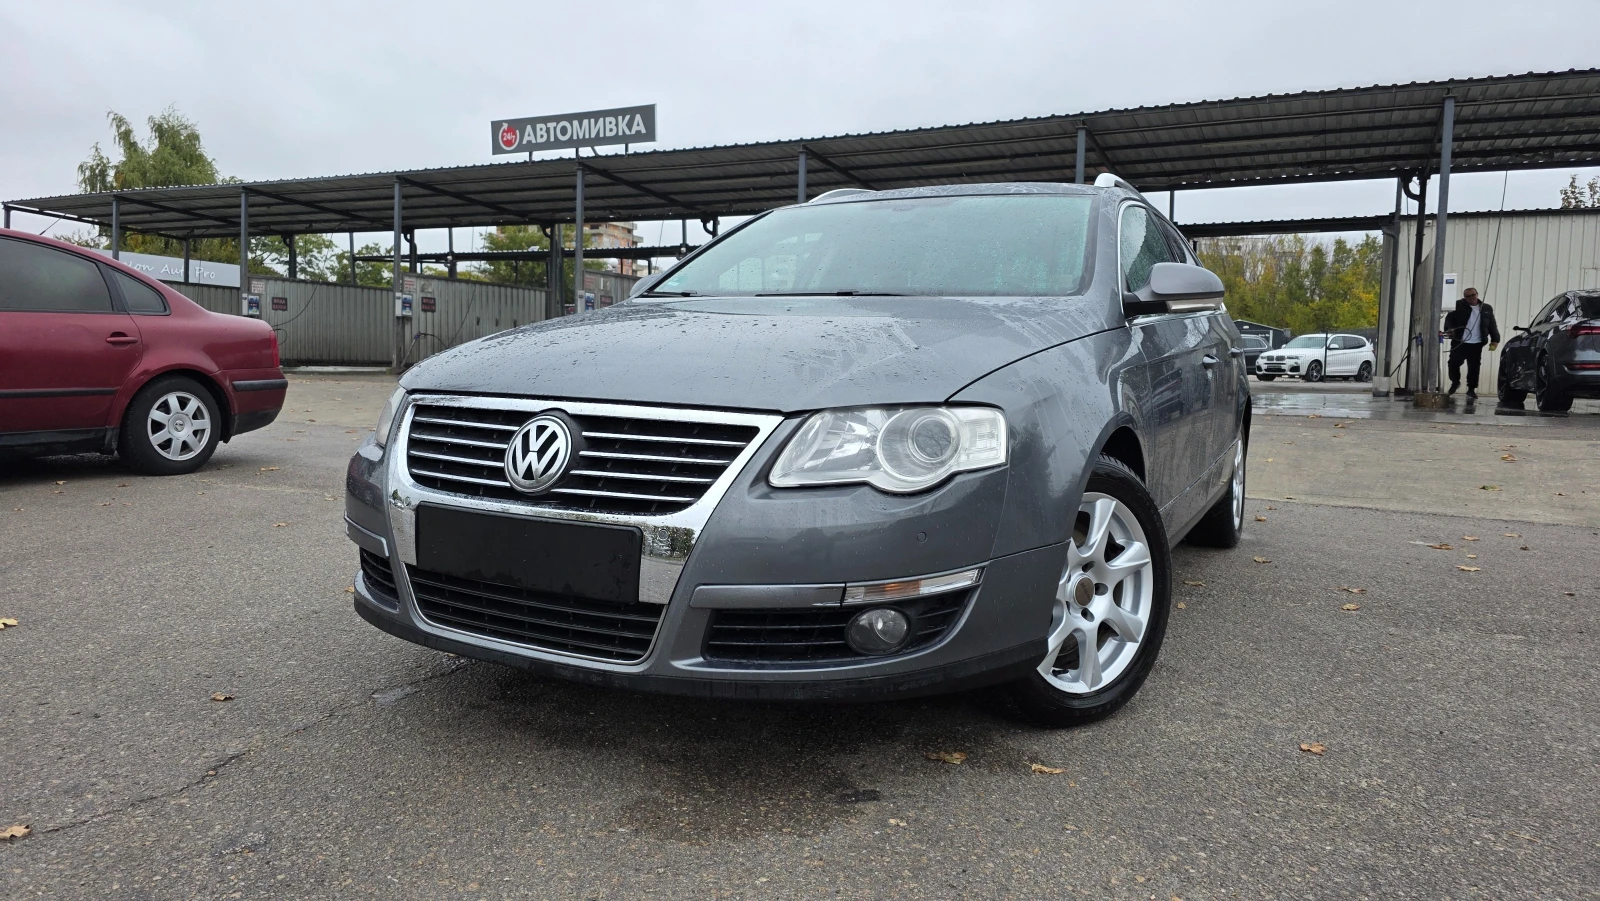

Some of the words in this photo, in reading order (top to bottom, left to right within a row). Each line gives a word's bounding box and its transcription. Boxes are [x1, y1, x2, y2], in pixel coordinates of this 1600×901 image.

[502, 132, 516, 143] 24/7
[522, 113, 646, 145] АВТОМИВКА
[160, 264, 188, 277] Aut
[195, 266, 216, 279] Pro
